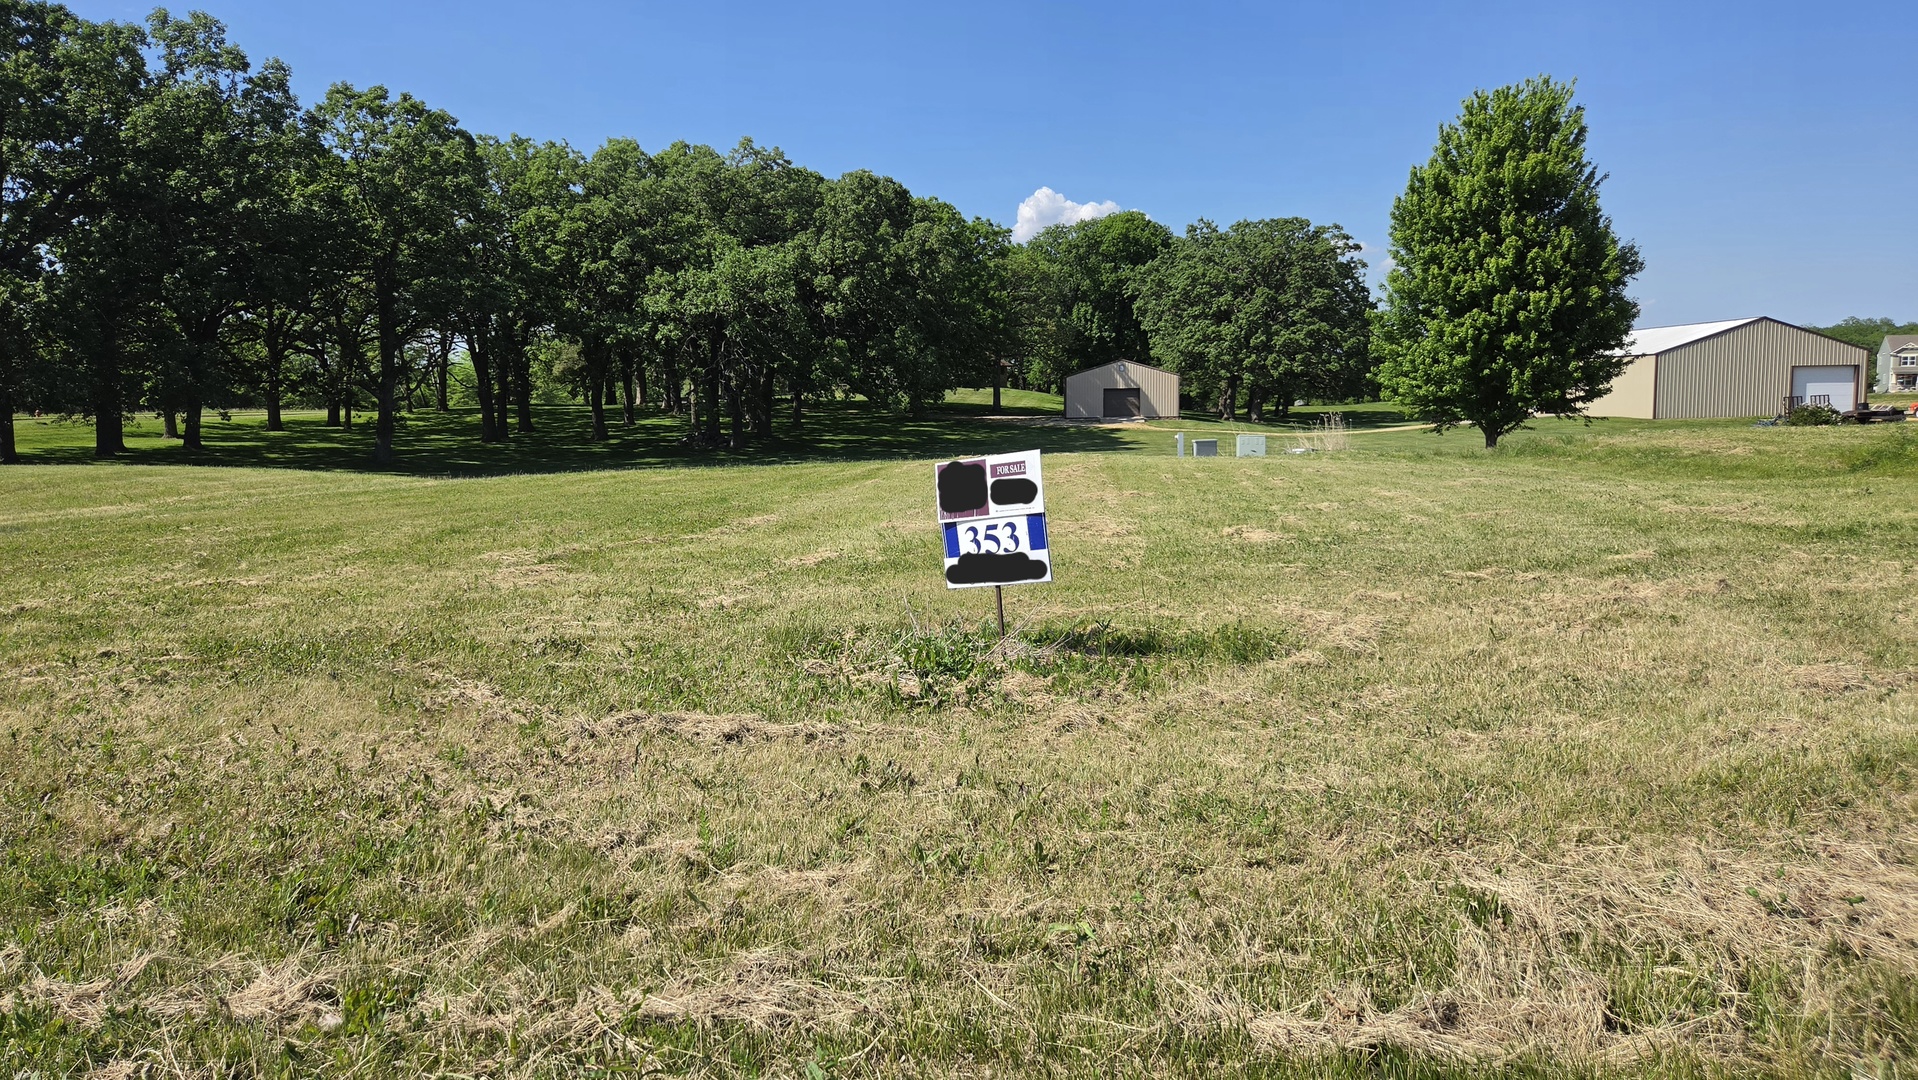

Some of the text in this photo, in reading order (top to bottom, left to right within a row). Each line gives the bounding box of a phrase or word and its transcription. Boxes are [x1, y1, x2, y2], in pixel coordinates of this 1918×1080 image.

[996, 463, 1026, 475] FOR SALE
[965, 521, 1020, 555] 353
